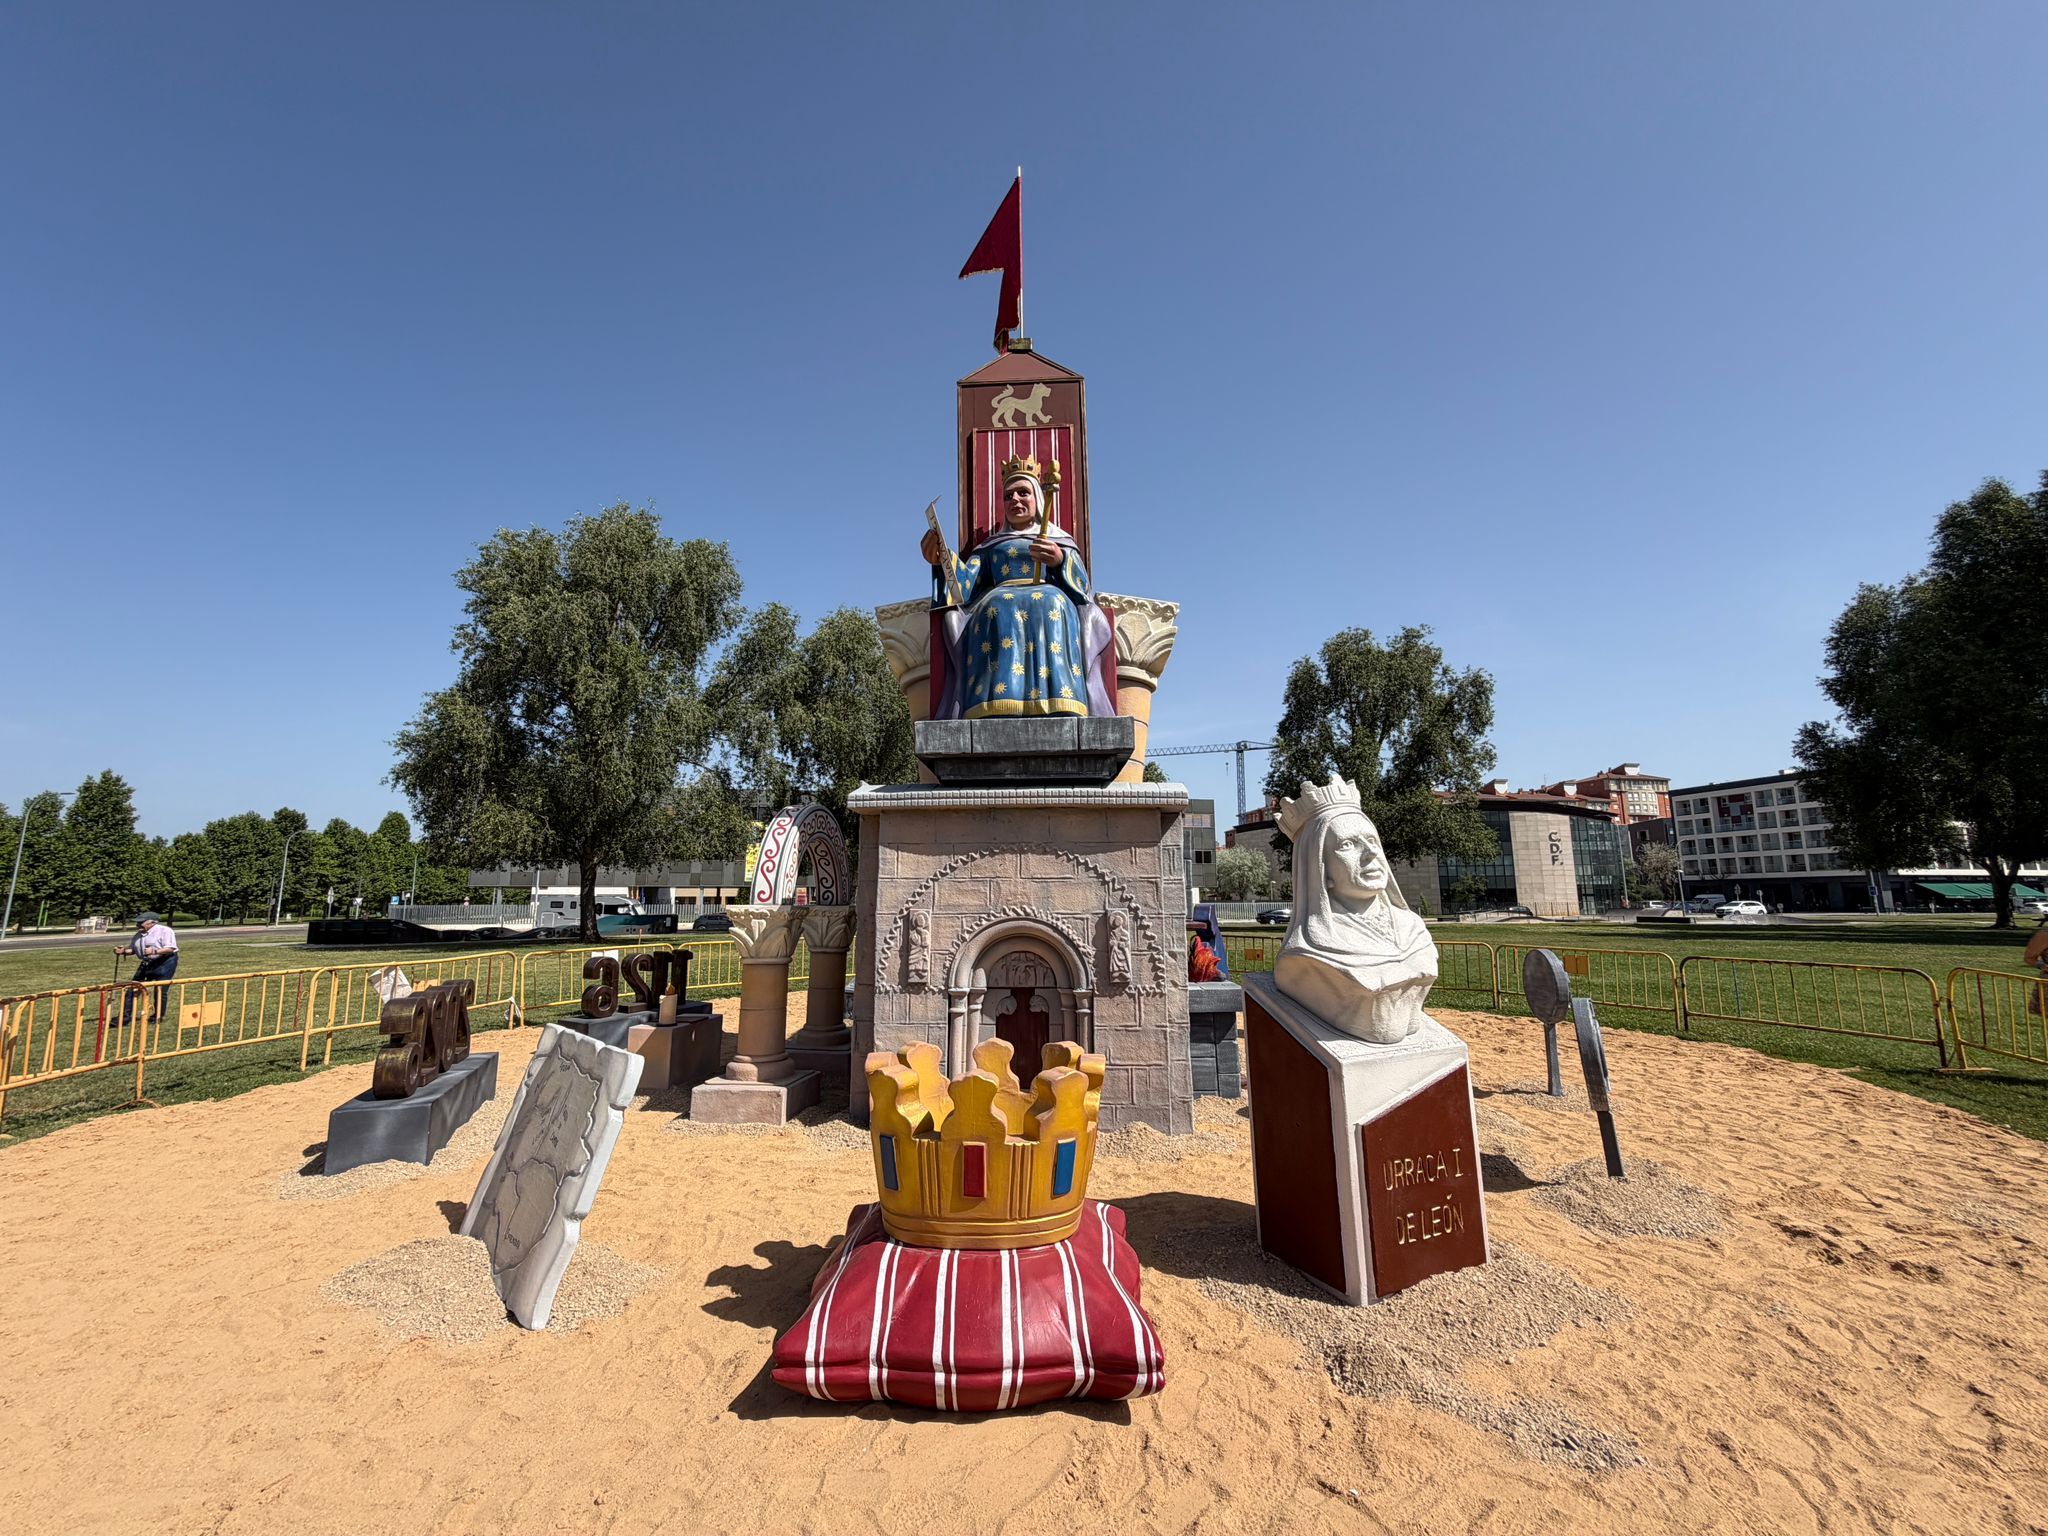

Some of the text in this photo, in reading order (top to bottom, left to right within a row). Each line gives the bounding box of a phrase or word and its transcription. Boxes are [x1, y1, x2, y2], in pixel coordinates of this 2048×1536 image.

[1383, 1148, 1464, 1191] URRACA I
[1396, 1193, 1465, 1245] DE LEÓN
